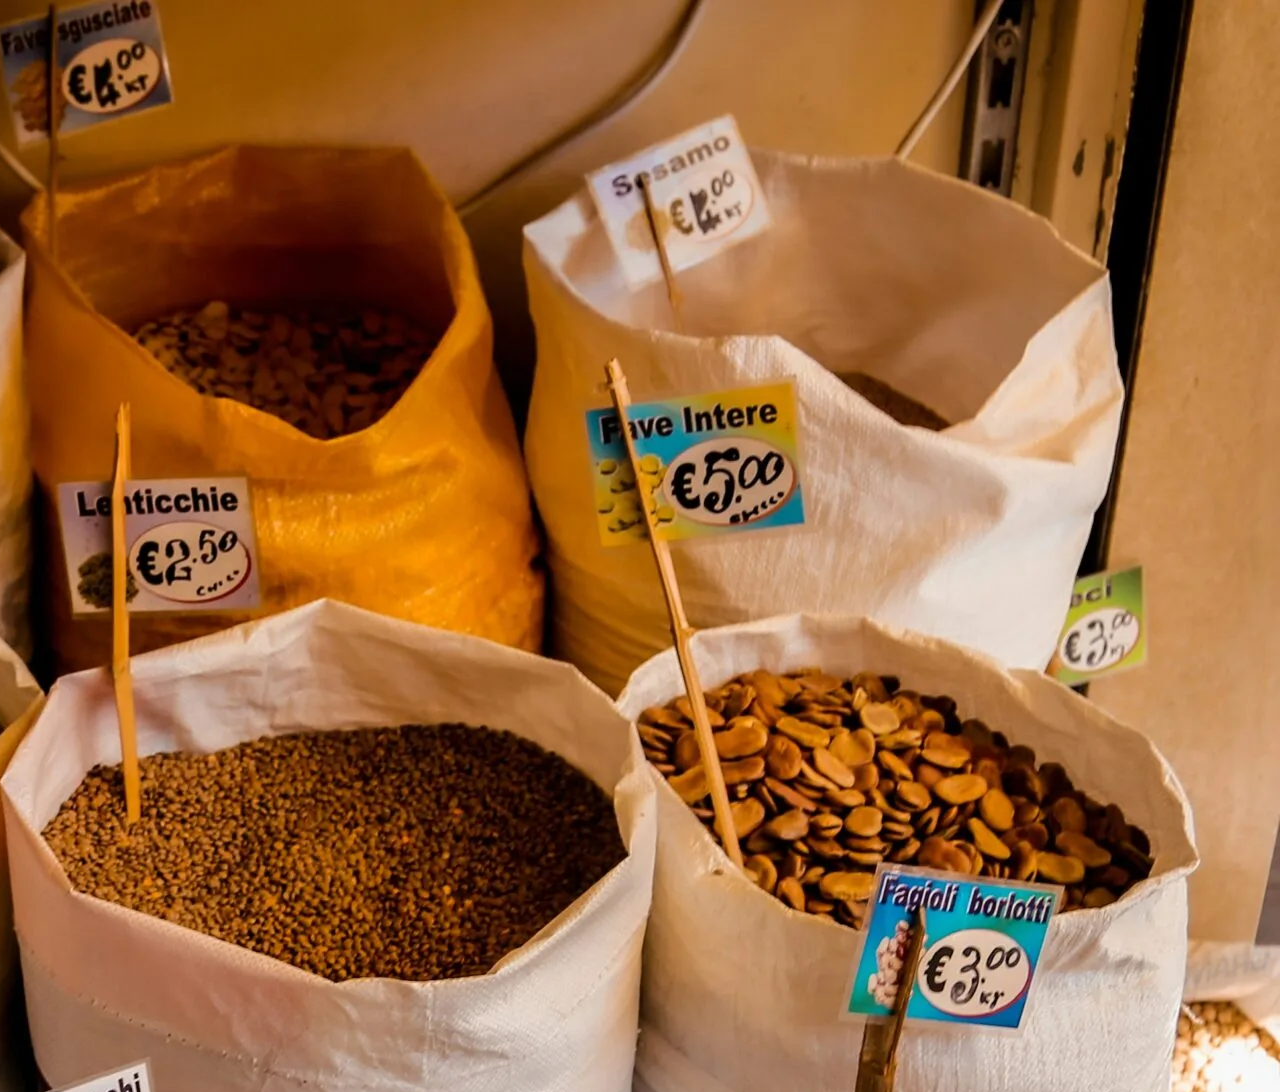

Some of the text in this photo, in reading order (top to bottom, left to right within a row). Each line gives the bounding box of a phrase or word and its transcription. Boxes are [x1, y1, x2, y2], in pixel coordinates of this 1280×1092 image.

[58, 0, 151, 42] sgusciate
[612, 136, 730, 197] Sesamo
[682, 402, 778, 434] Intere
[878, 876, 1052, 924] Fagioli borlotti
